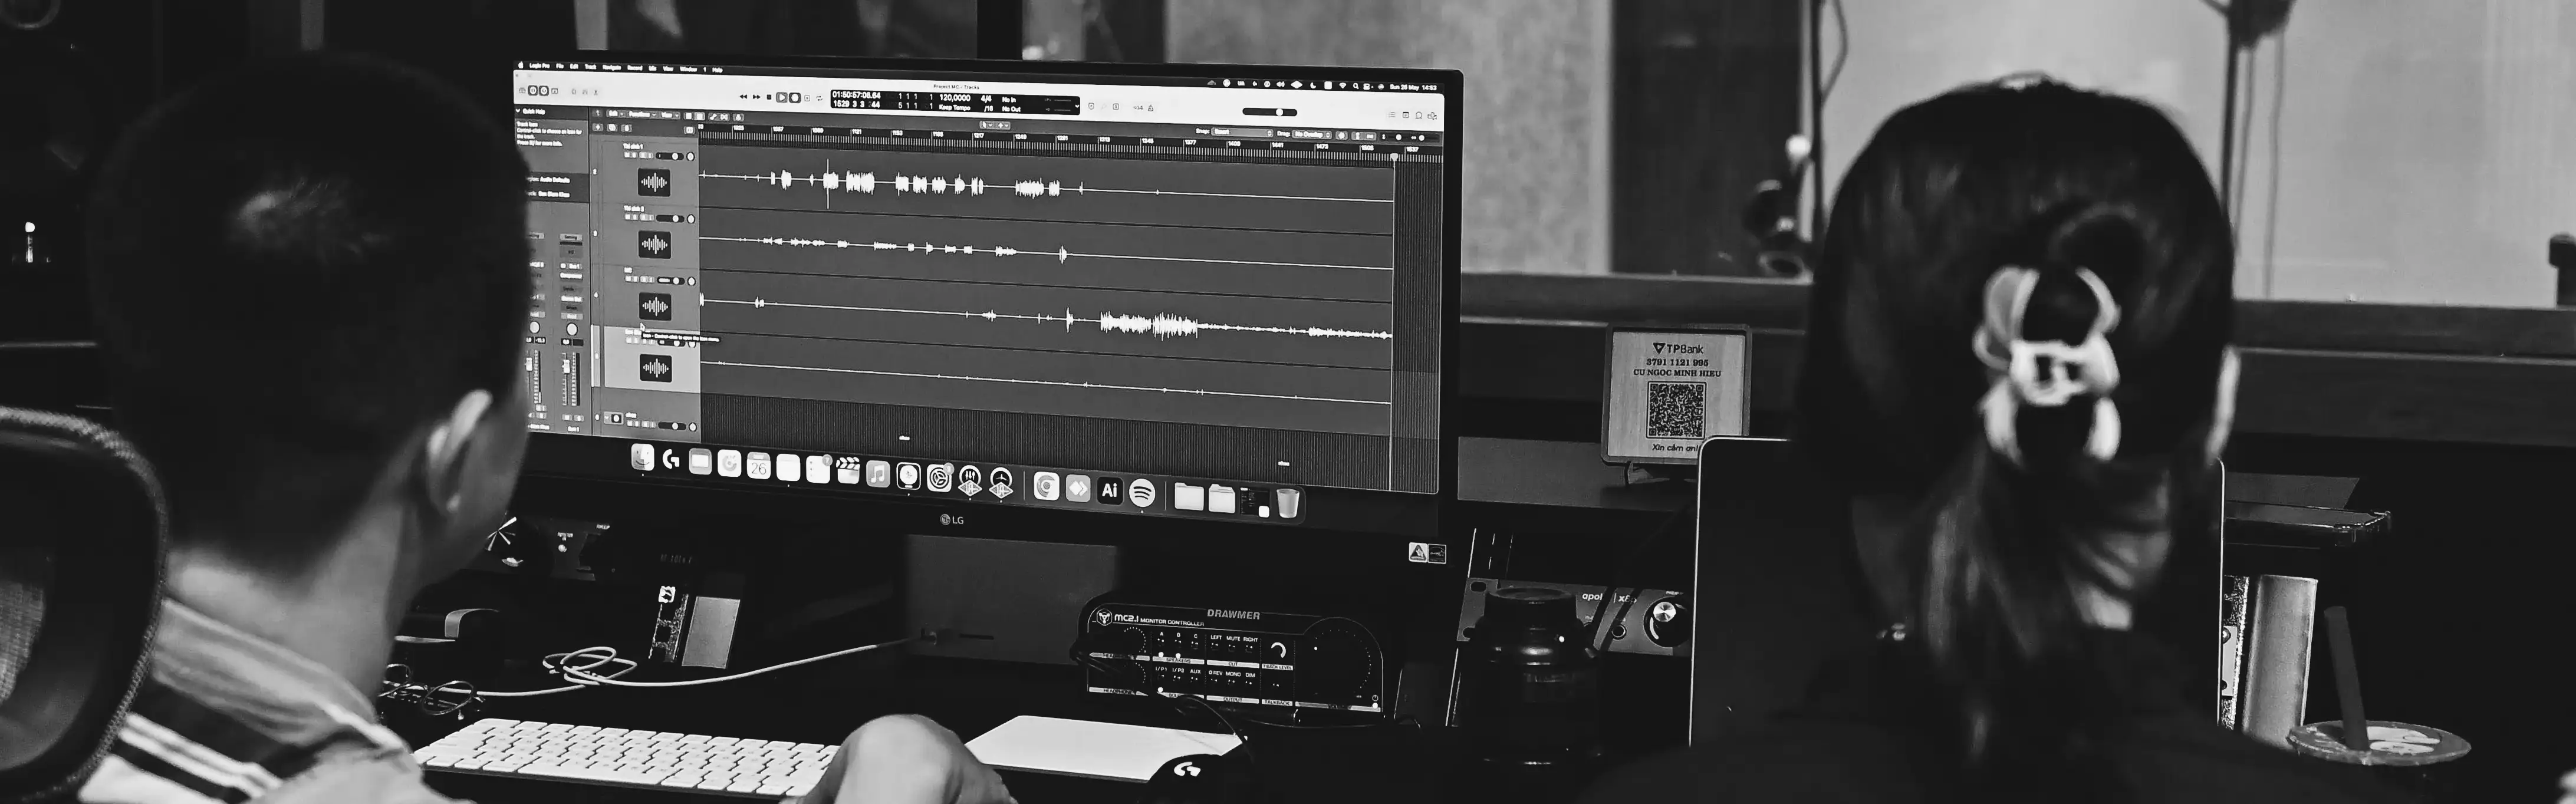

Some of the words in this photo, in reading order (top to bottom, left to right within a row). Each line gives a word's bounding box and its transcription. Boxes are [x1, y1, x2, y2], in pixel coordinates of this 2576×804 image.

[939, 94, 971, 102] 120,0000
[1667, 344, 1703, 354] TPBank
[1646, 358, 1667, 367] 3791
[1670, 358, 1690, 367] 1121
[1693, 359, 1709, 367] 995
[1652, 443, 1665, 452] Xin
[751, 462, 767, 475] 26
[1101, 483, 1117, 497] Ai
[952, 516, 964, 525] LG
[1582, 592, 1603, 601] apol
[1207, 609, 1261, 620] DRAWMER
